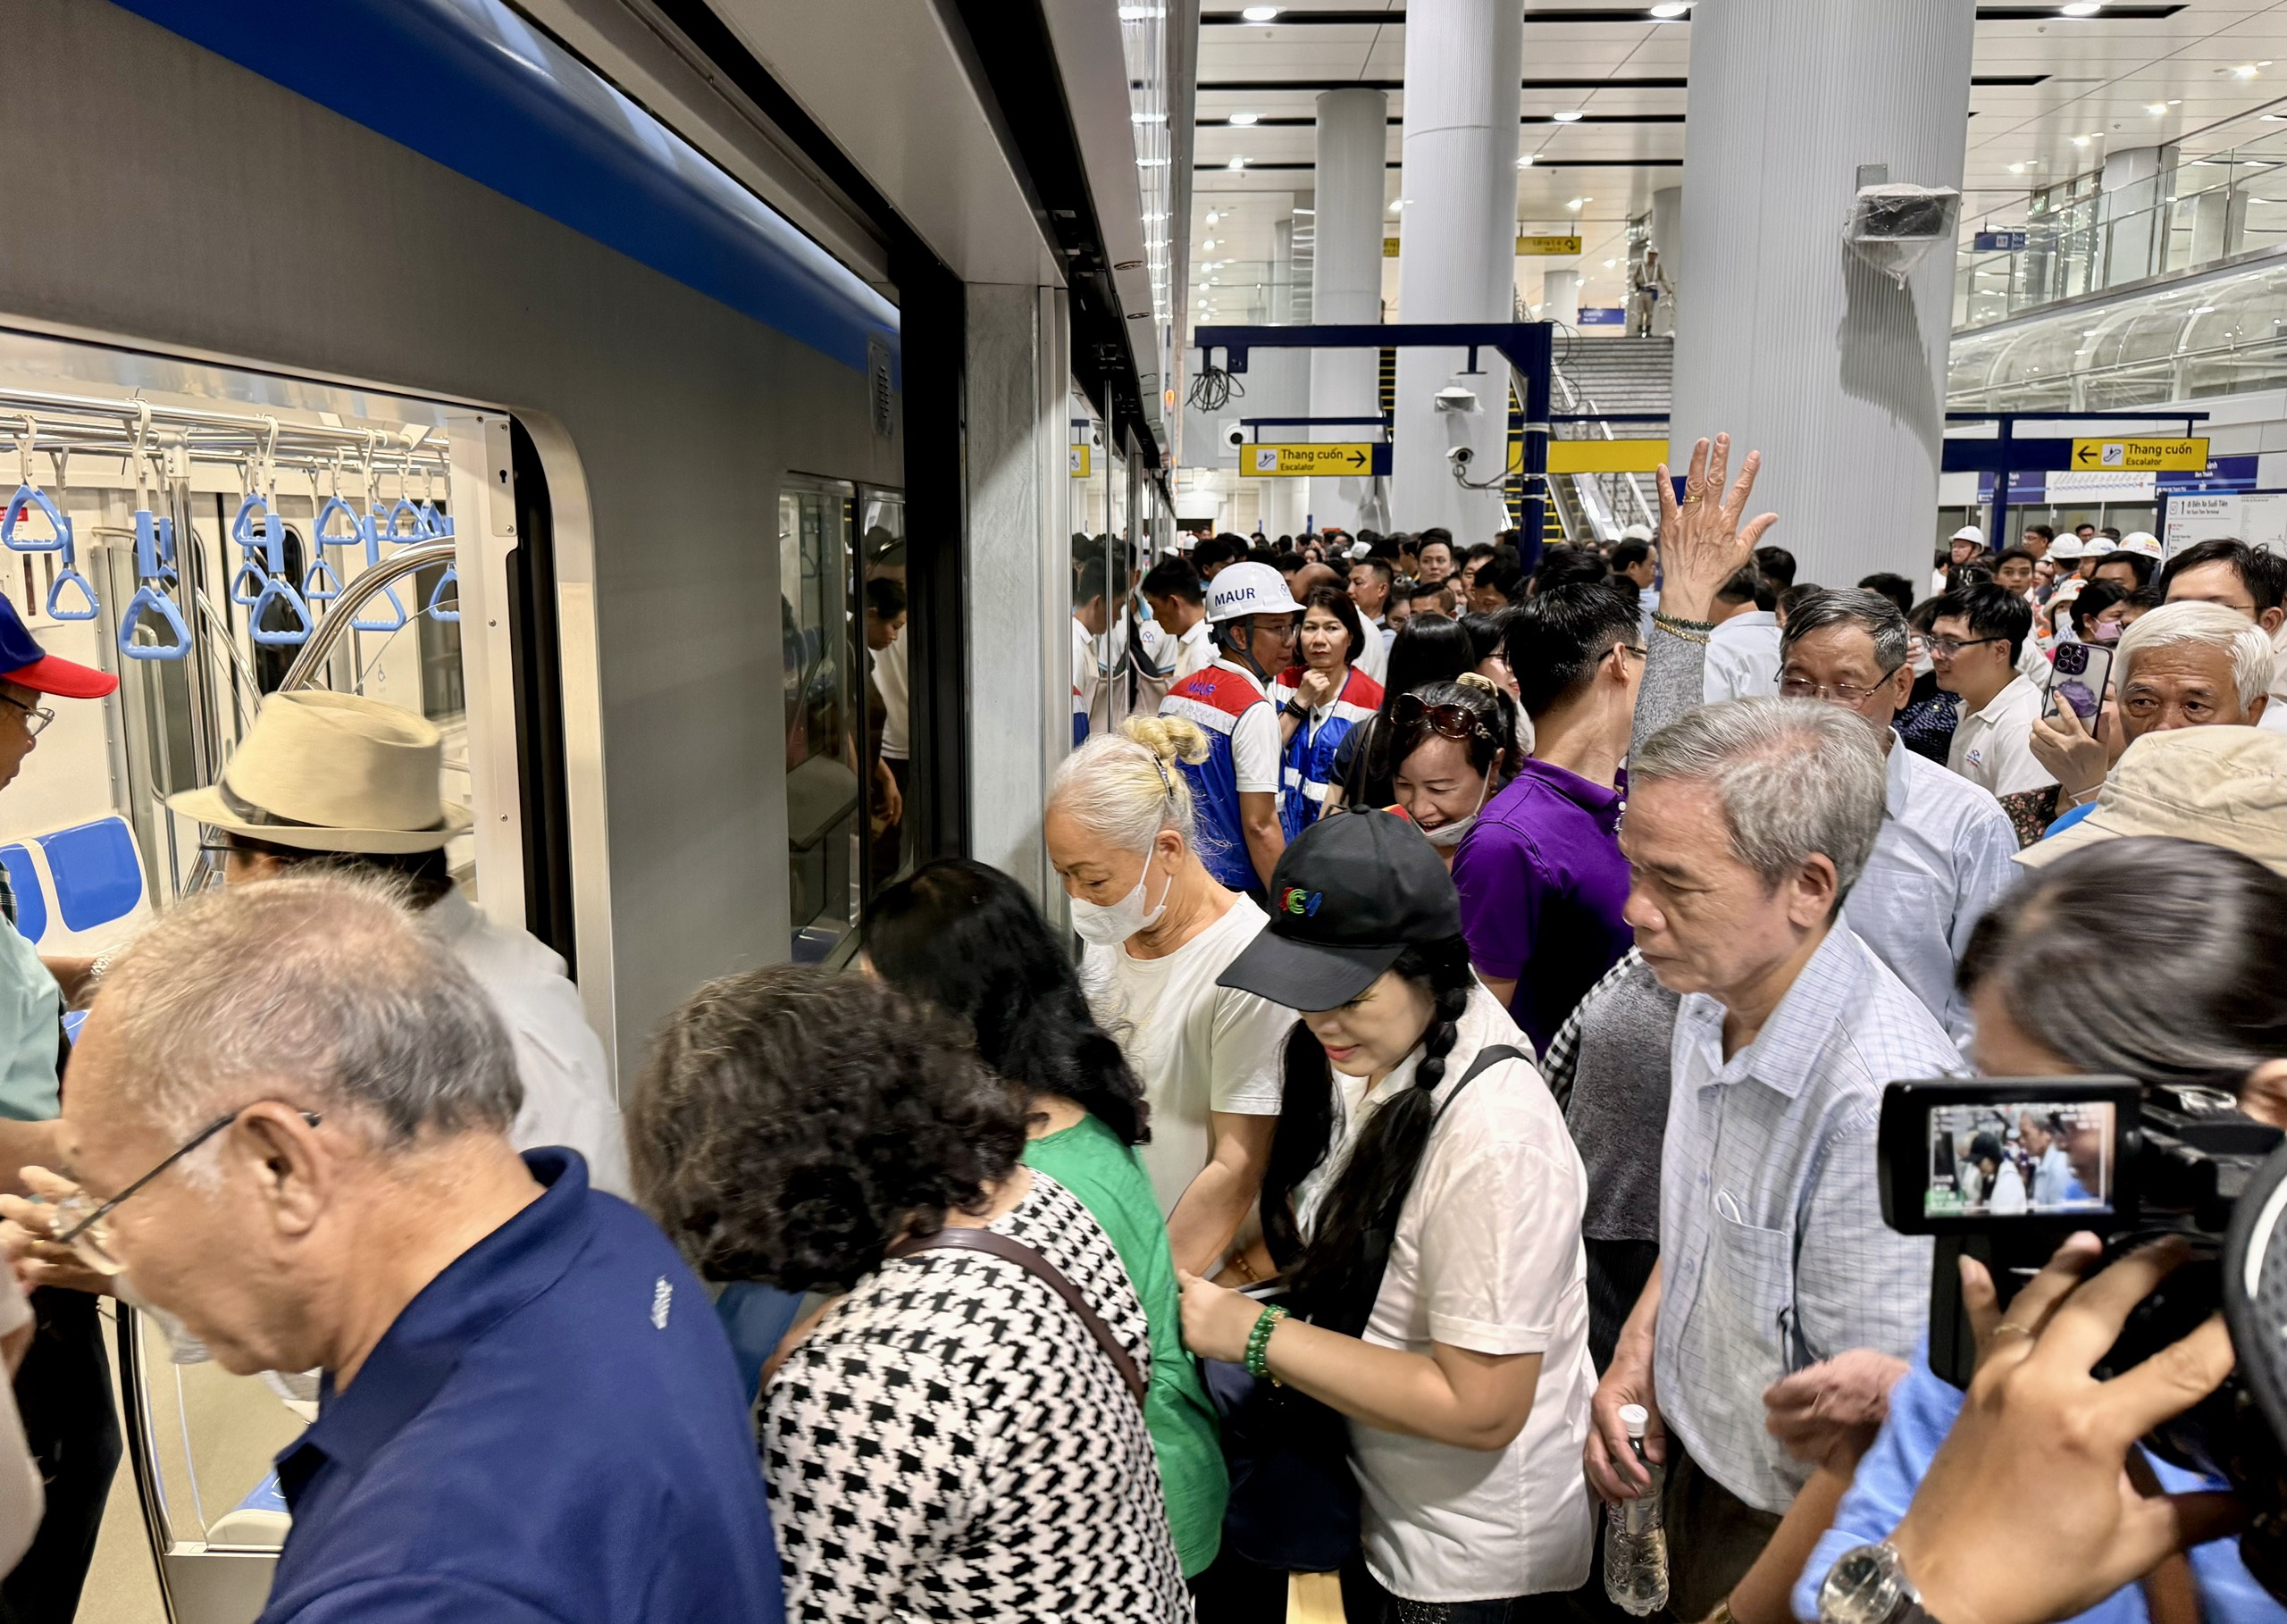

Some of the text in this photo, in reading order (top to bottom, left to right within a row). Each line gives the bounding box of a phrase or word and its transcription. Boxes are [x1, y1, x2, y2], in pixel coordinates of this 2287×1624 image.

[1282, 448, 1344, 461] Thang cuốn
[2128, 442, 2192, 456] Thang cuốn
[1281, 463, 1315, 471] Escalator
[2126, 457, 2162, 466] Escalator
[1215, 587, 1255, 607] MAUR
[1187, 682, 1216, 696] MAUR
